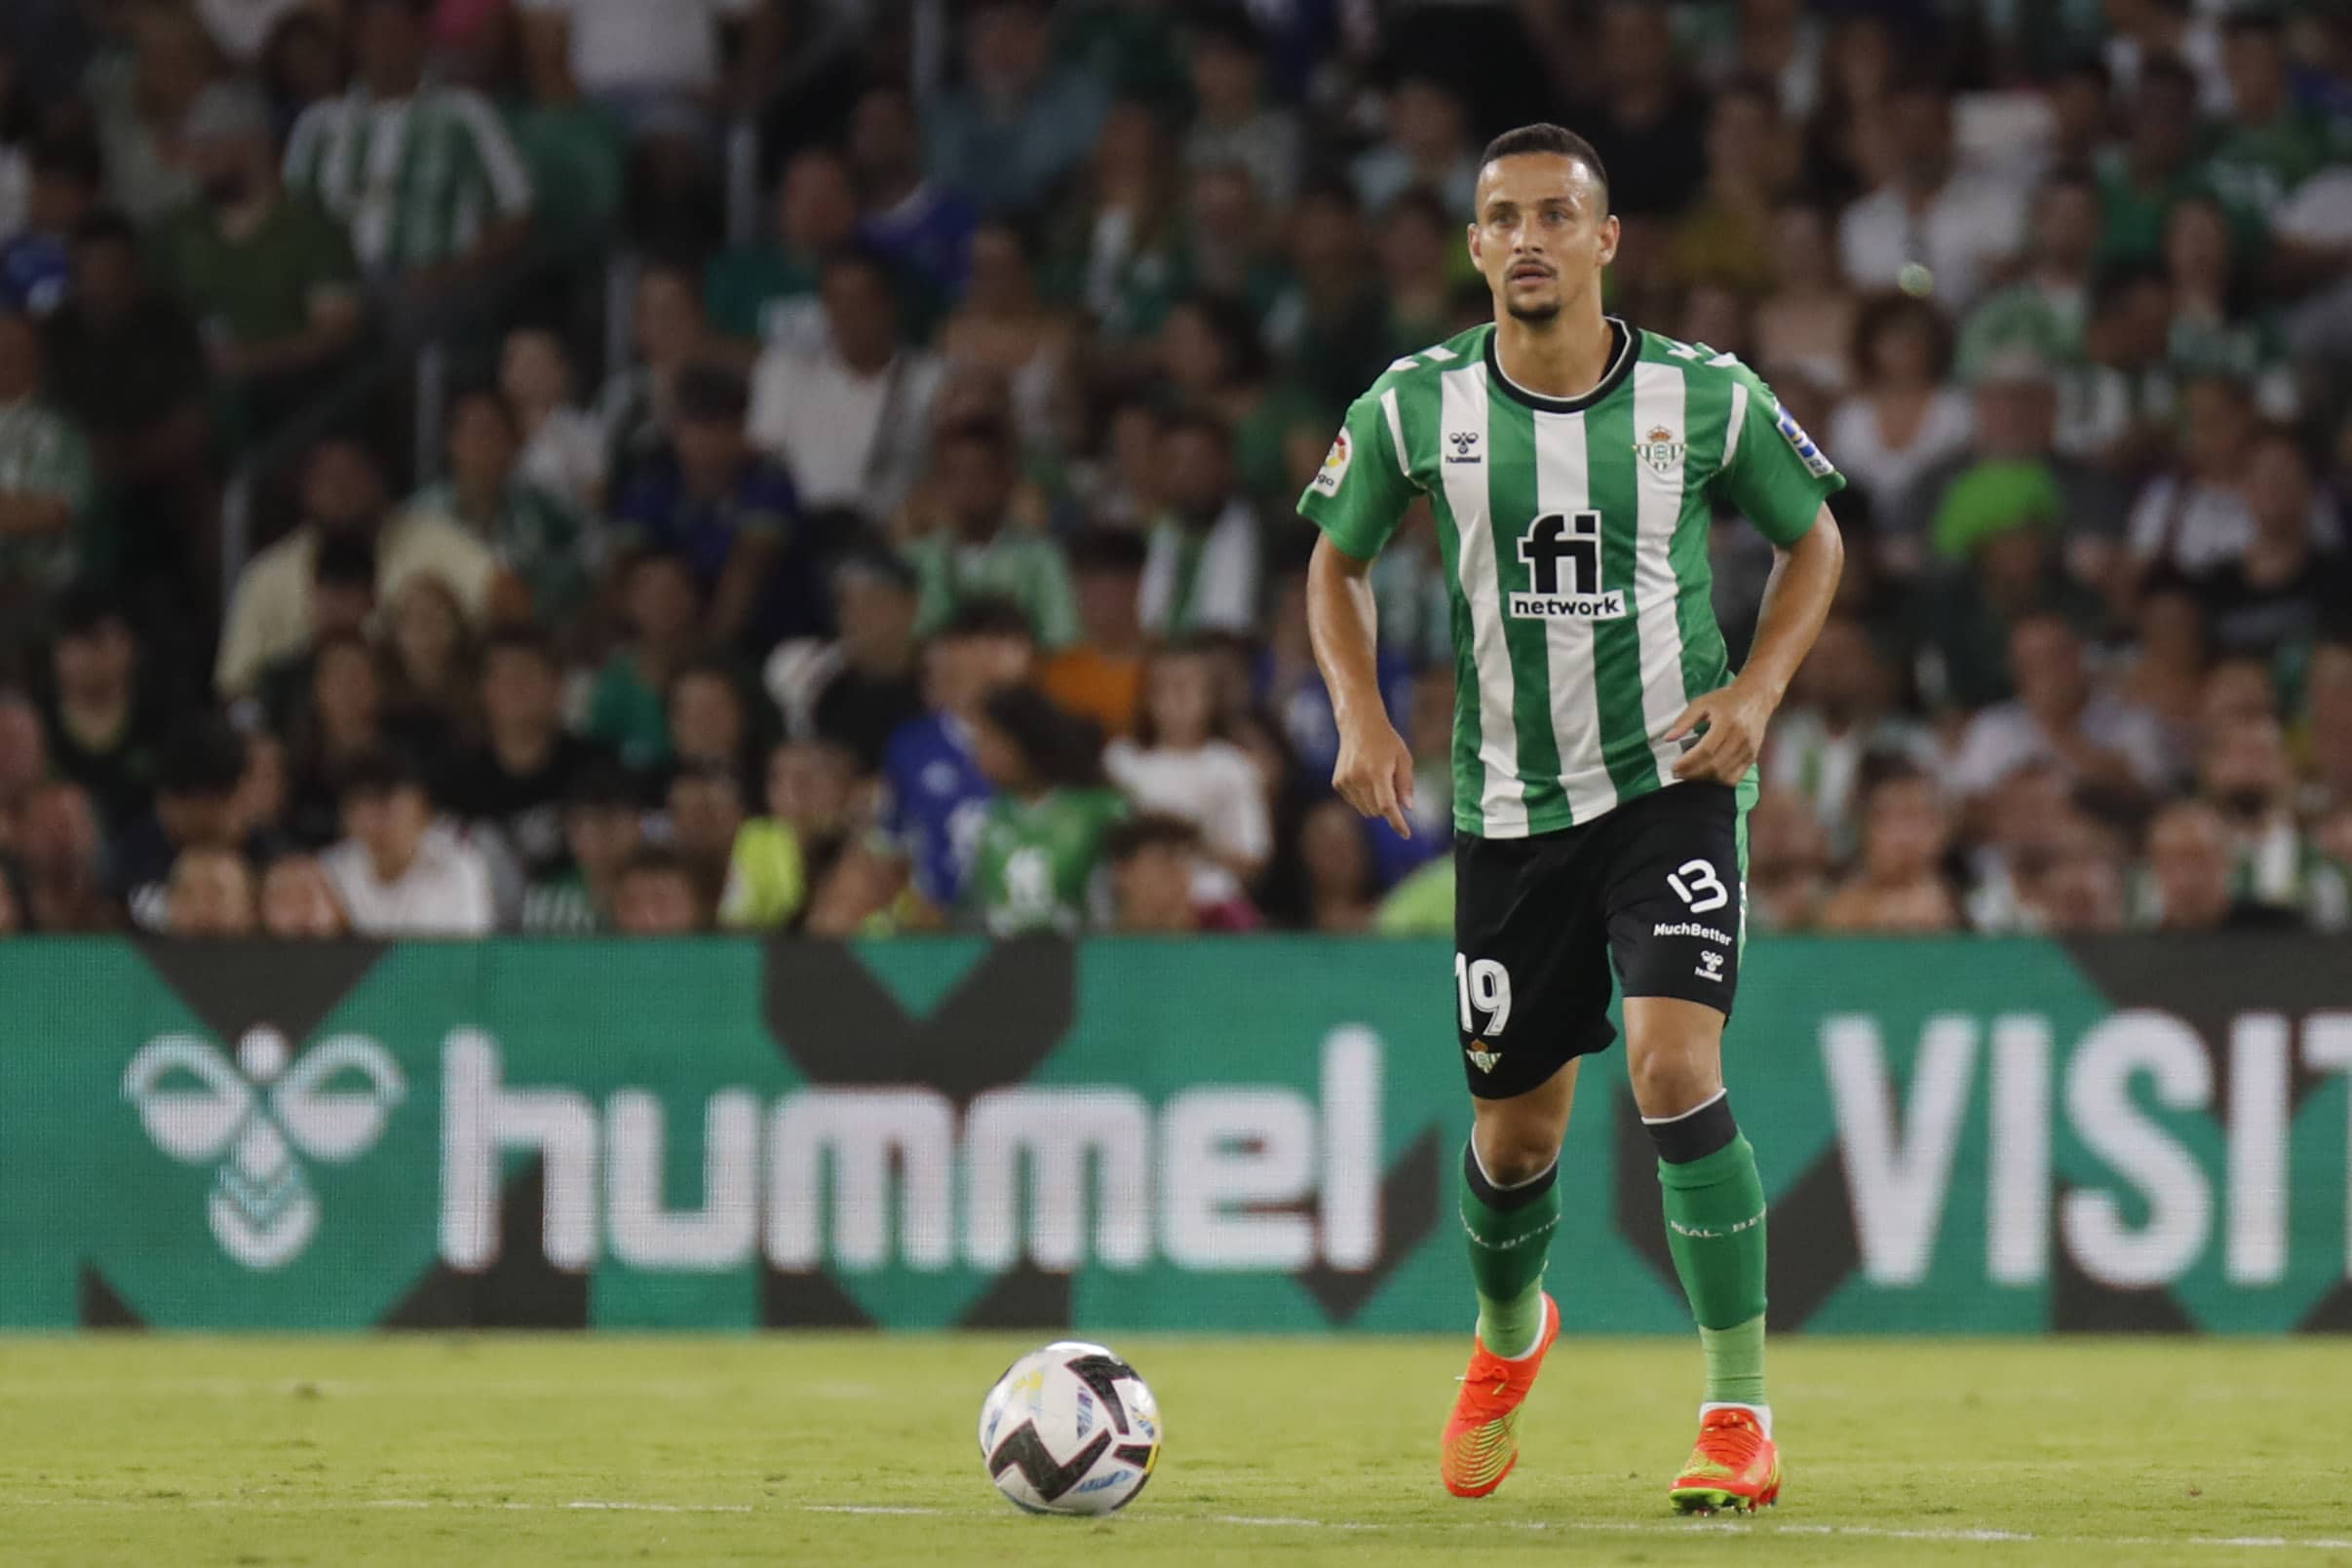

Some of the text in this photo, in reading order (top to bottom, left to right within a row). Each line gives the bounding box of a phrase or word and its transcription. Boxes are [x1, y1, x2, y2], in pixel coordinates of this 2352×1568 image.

[1523, 514, 1598, 594] fi
[1514, 596, 1620, 617] network
[1653, 922, 1732, 946] MuchBetter
[1454, 951, 1512, 1036] 19
[440, 1025, 1382, 1271] hummel
